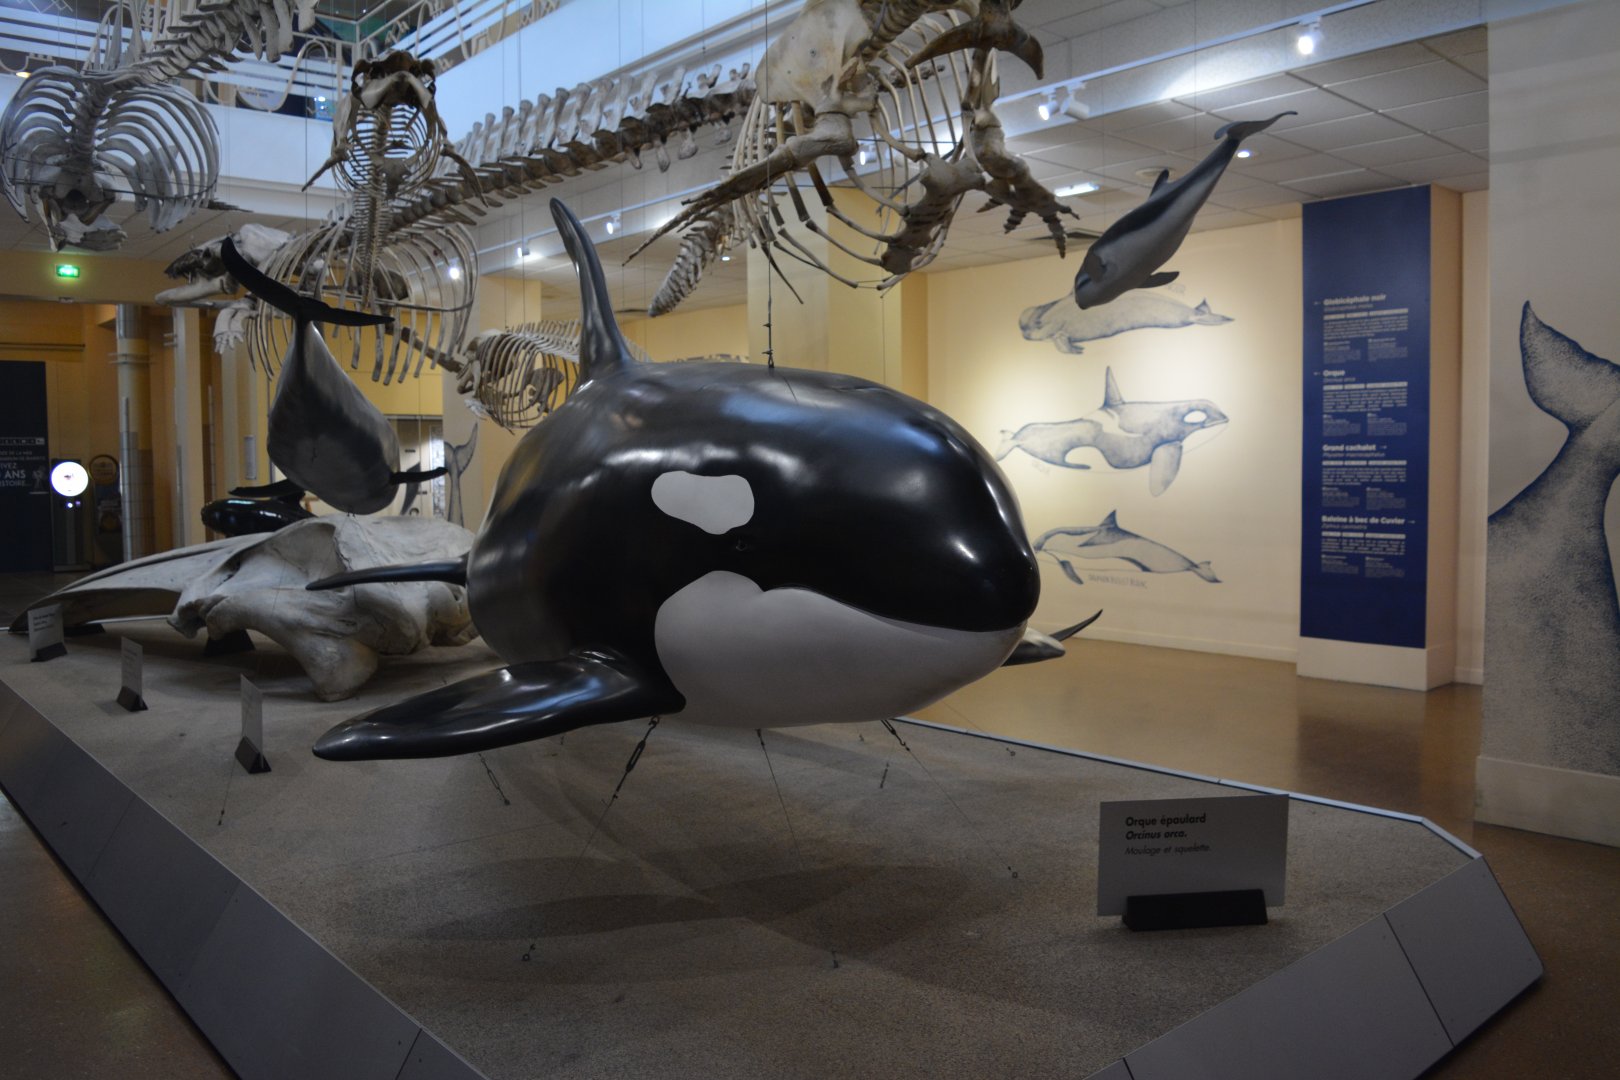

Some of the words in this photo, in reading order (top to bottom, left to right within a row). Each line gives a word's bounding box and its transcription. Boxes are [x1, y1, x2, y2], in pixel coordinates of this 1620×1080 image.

[1323, 369, 1345, 378] Orque
[4, 469, 26, 479] ANS
[1321, 515, 1347, 523] Baleine
[1355, 515, 1368, 523] bec
[1380, 516, 1405, 525] Cuvier
[1125, 816, 1157, 829] Orque
[1160, 812, 1206, 828] épaulard
[1125, 830, 1161, 840] Orcinus
[1163, 830, 1188, 839] orca.
[1124, 844, 1161, 857] Moulage
[1163, 846, 1172, 854] et
